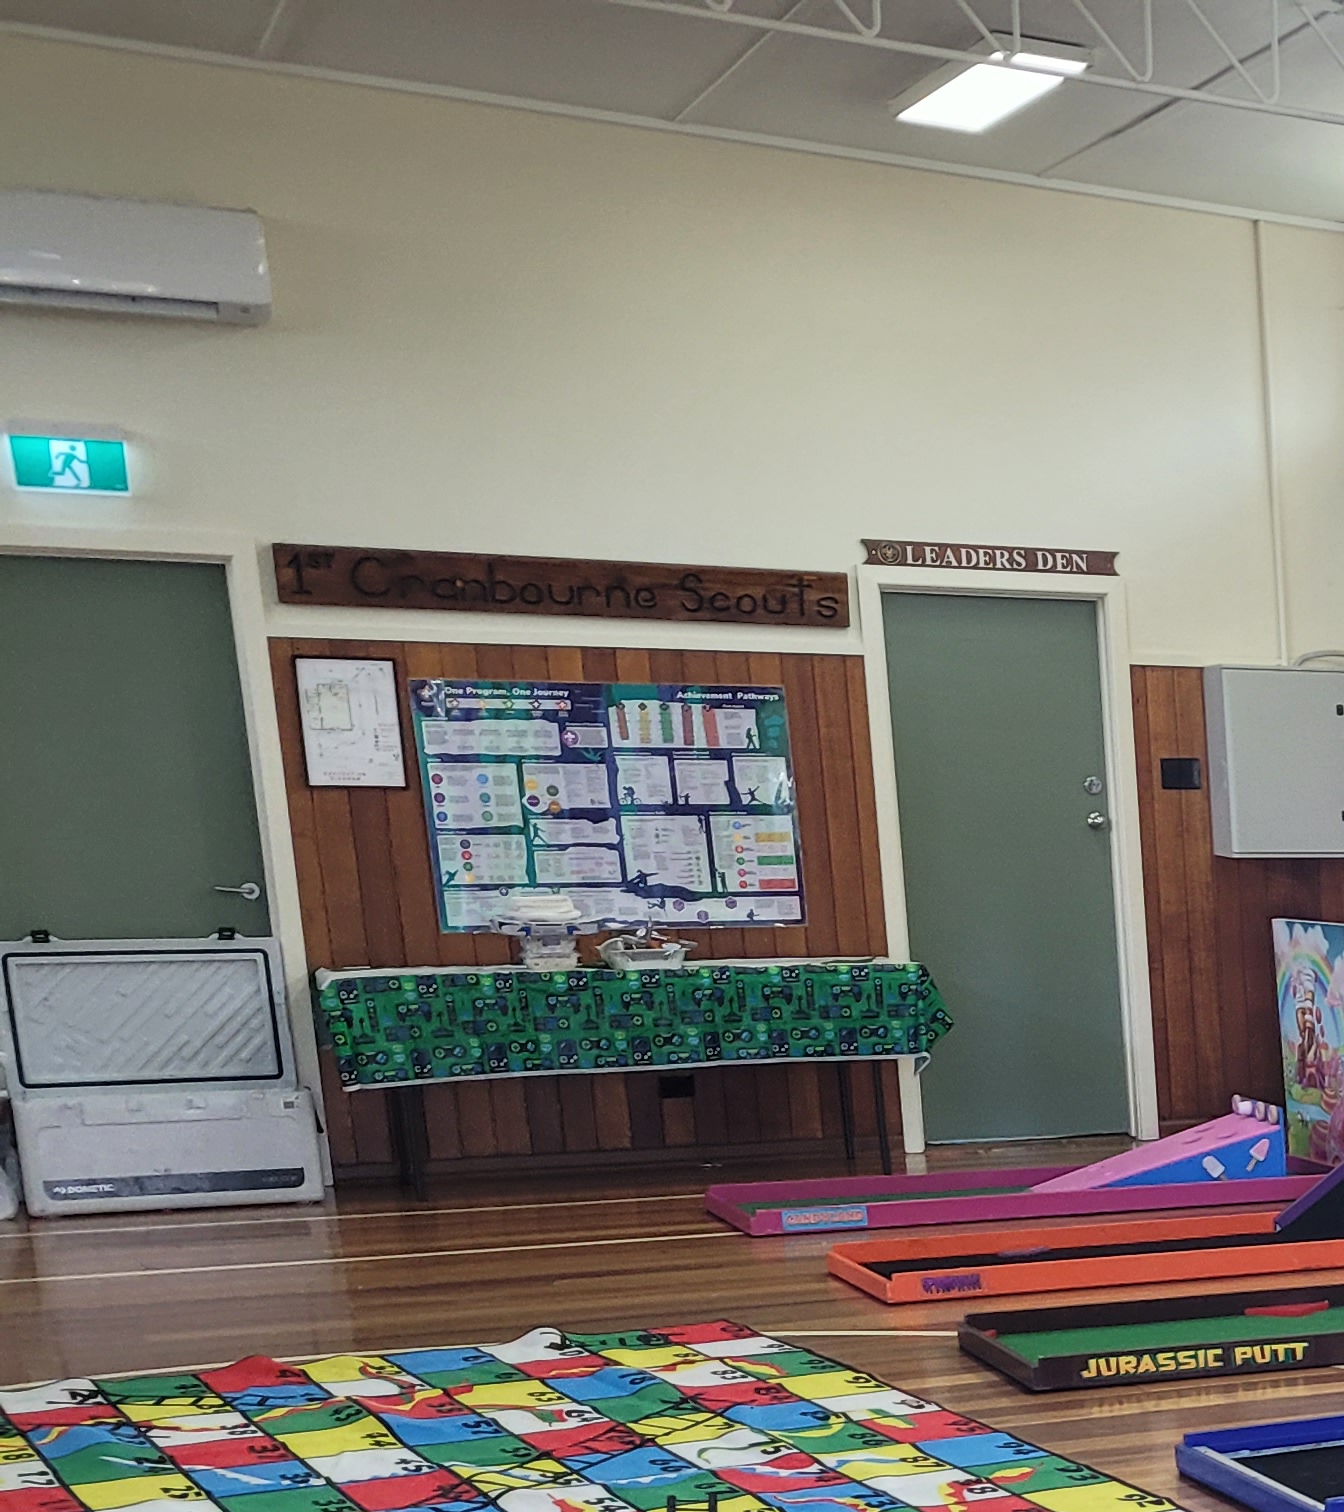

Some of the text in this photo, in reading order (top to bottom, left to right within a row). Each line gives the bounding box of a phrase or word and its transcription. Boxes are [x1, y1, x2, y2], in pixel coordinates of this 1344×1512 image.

[906, 545, 1088, 572] LEADERS DEN
[352, 556, 658, 609] Cranbourne
[680, 573, 840, 618] Scouts
[445, 687, 464, 695] One
[512, 688, 532, 696] One
[533, 688, 569, 698] Journey
[676, 691, 780, 701] Achievement Pathways
[1081, 1342, 1310, 1379] JURASSIC PUTT
[710, 1369, 748, 1380] 83
[844, 1375, 886, 1389] 97
[527, 1391, 565, 1403] 63
[565, 1409, 605, 1422] 64
[361, 1431, 398, 1448] 44
[848, 1432, 892, 1446] 86
[995, 1441, 1040, 1456] 94
[394, 1458, 436, 1474] 45
[648, 1458, 692, 1473] 66
[159, 1485, 203, 1499] 25
[583, 1497, 630, 1512] 54
